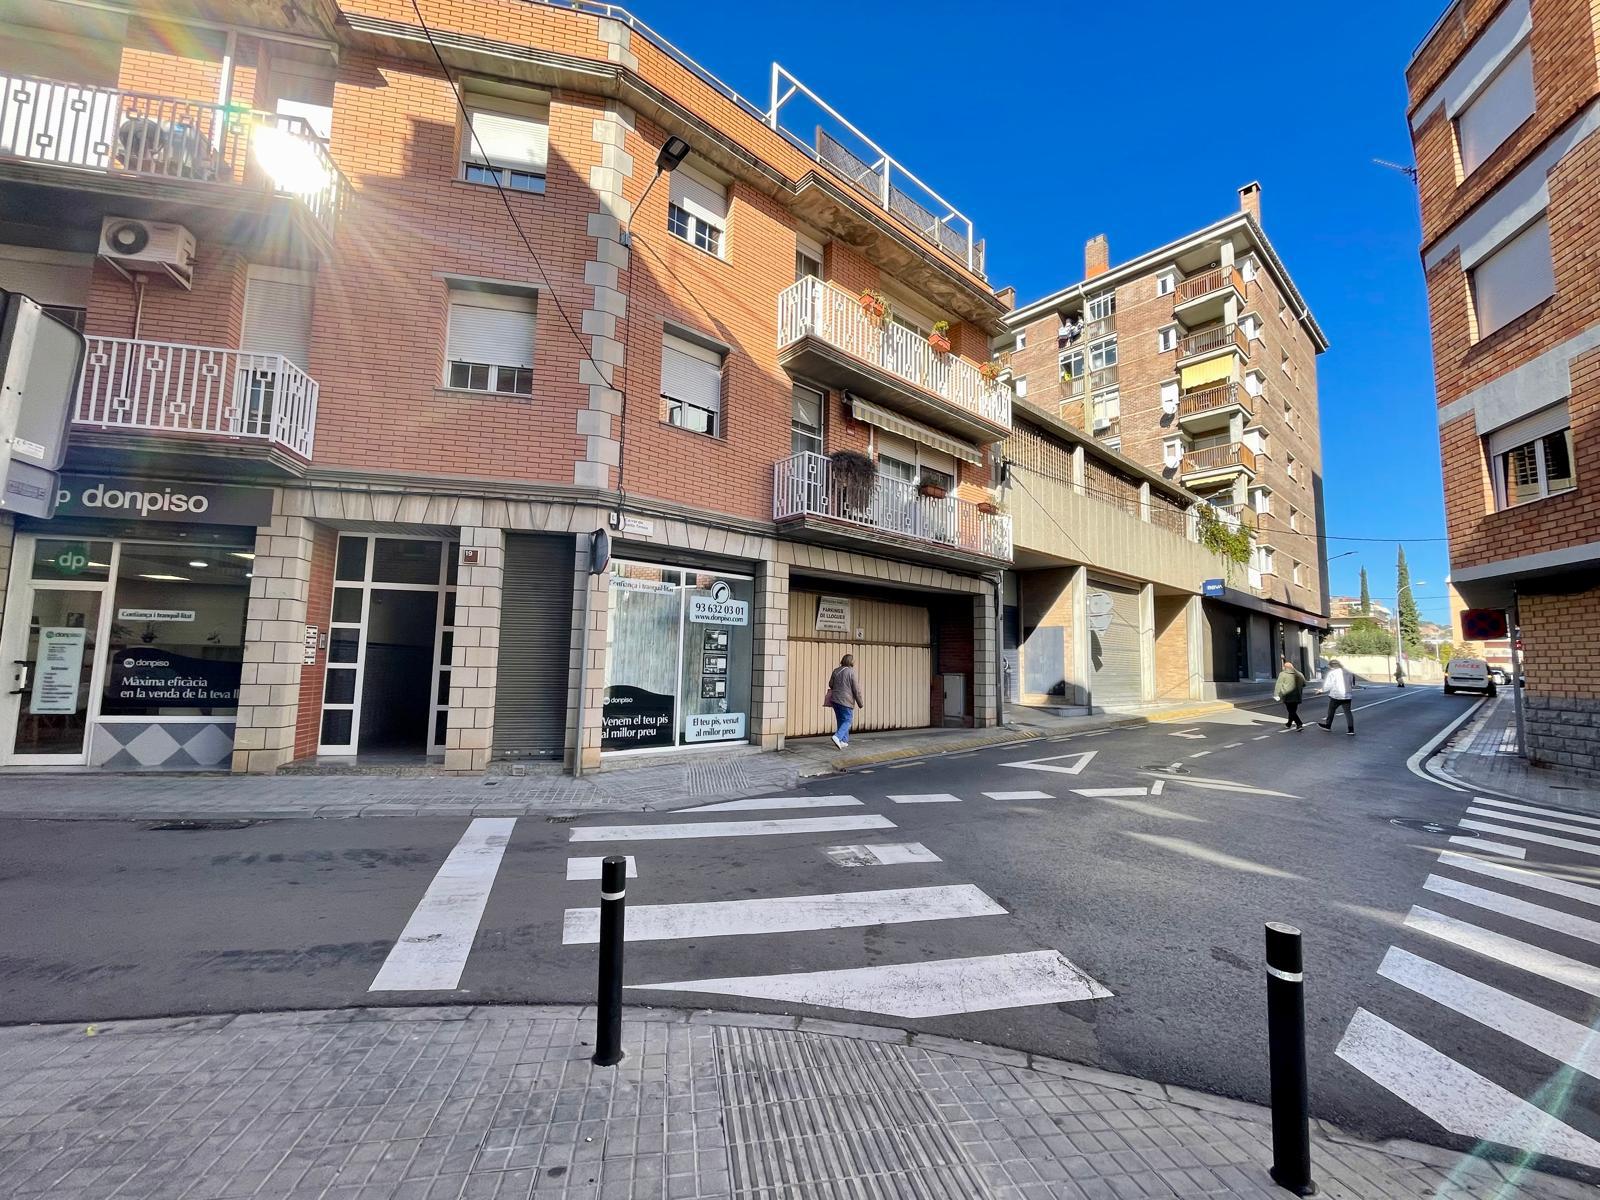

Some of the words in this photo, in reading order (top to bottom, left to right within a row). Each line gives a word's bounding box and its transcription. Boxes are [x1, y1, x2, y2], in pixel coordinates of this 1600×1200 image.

[81, 484, 209, 517] donpiso
[58, 552, 85, 570] dp
[695, 602, 706, 613] 93
[707, 603, 723, 614] 632
[724, 605, 734, 615] 03
[735, 606, 744, 616] 01
[695, 614, 744, 623] www.donpiso.com
[136, 659, 170, 668] donpiso
[121, 676, 165, 687] Màxima
[167, 676, 208, 687] eficàcia
[120, 690, 134, 698] en
[136, 688, 146, 698] la
[149, 688, 180, 698] venda
[182, 689, 196, 699] de
[198, 689, 207, 699] la
[210, 690, 231, 699] teva
[610, 696, 634, 705] donpiso
[602, 715, 632, 727] Venem
[633, 714, 641, 725] el
[643, 716, 656, 725] teu
[657, 714, 668, 726] pis
[692, 718, 699, 727] El
[700, 718, 710, 726] teu
[722, 716, 740, 725] venut
[601, 728, 609, 739] al
[611, 727, 637, 738] millor
[638, 728, 656, 739] preu
[695, 728, 702, 737] al
[702, 727, 720, 736] millor
[722, 728, 736, 738] preu
